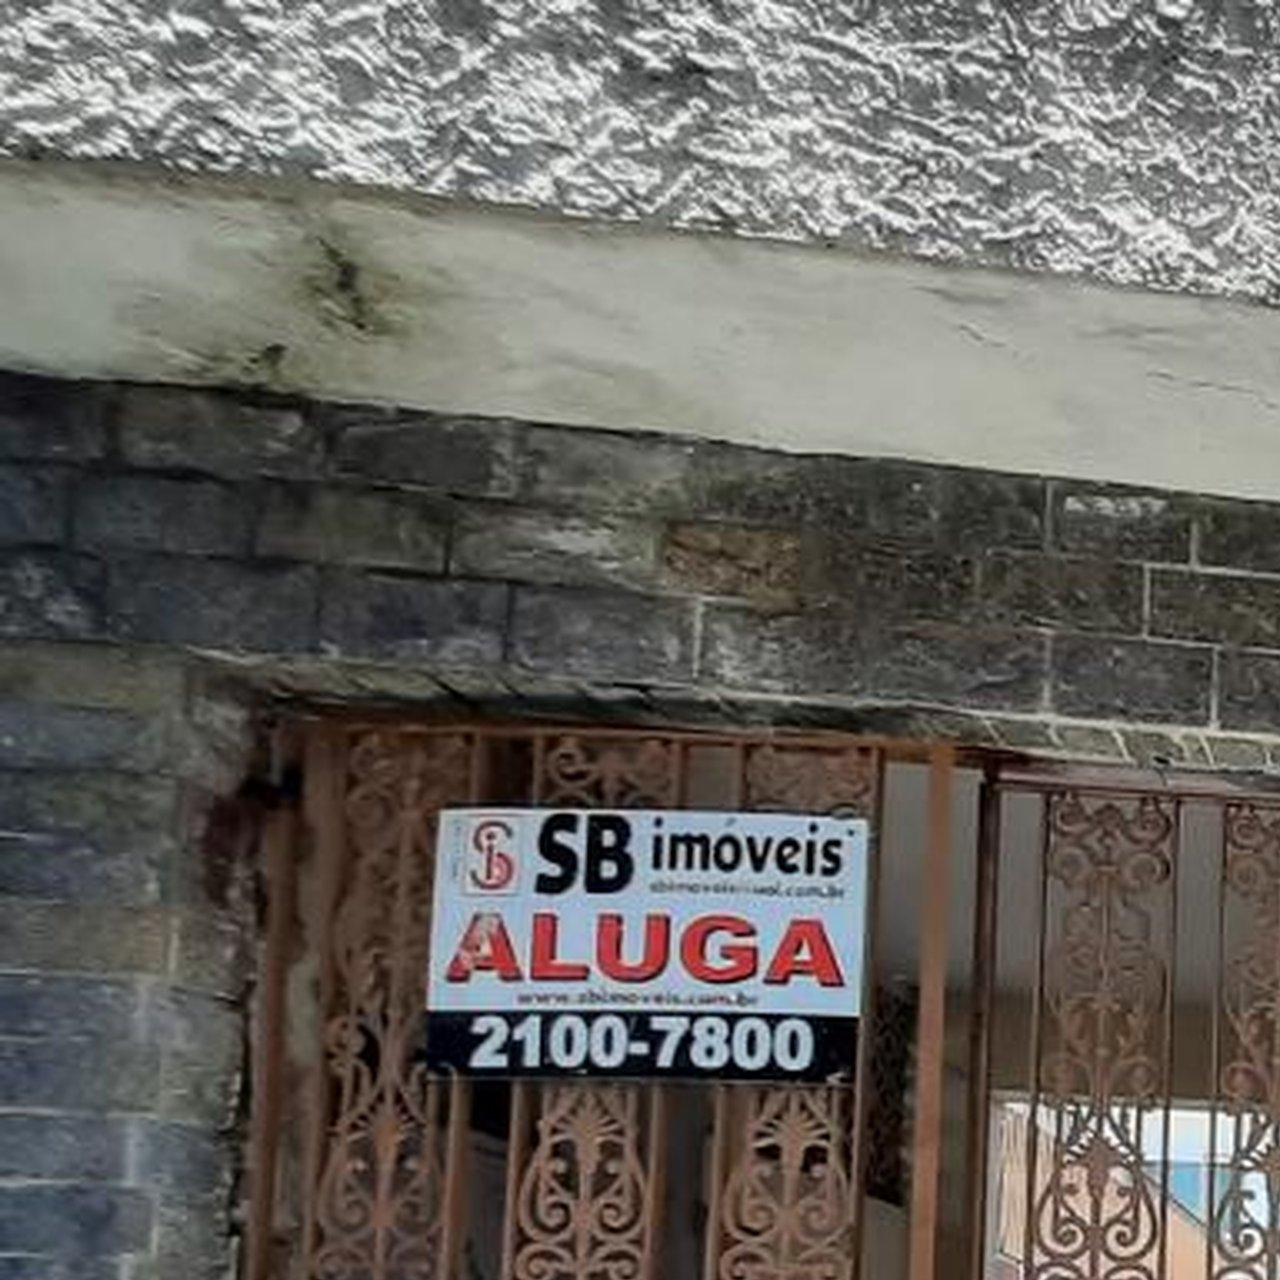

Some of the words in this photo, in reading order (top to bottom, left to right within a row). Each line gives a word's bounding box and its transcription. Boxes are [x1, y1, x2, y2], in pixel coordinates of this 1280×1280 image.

[534, 812, 634, 896] SB
[446, 911, 846, 987] ALUGA
[468, 1014, 815, 1071] 2100-7800
